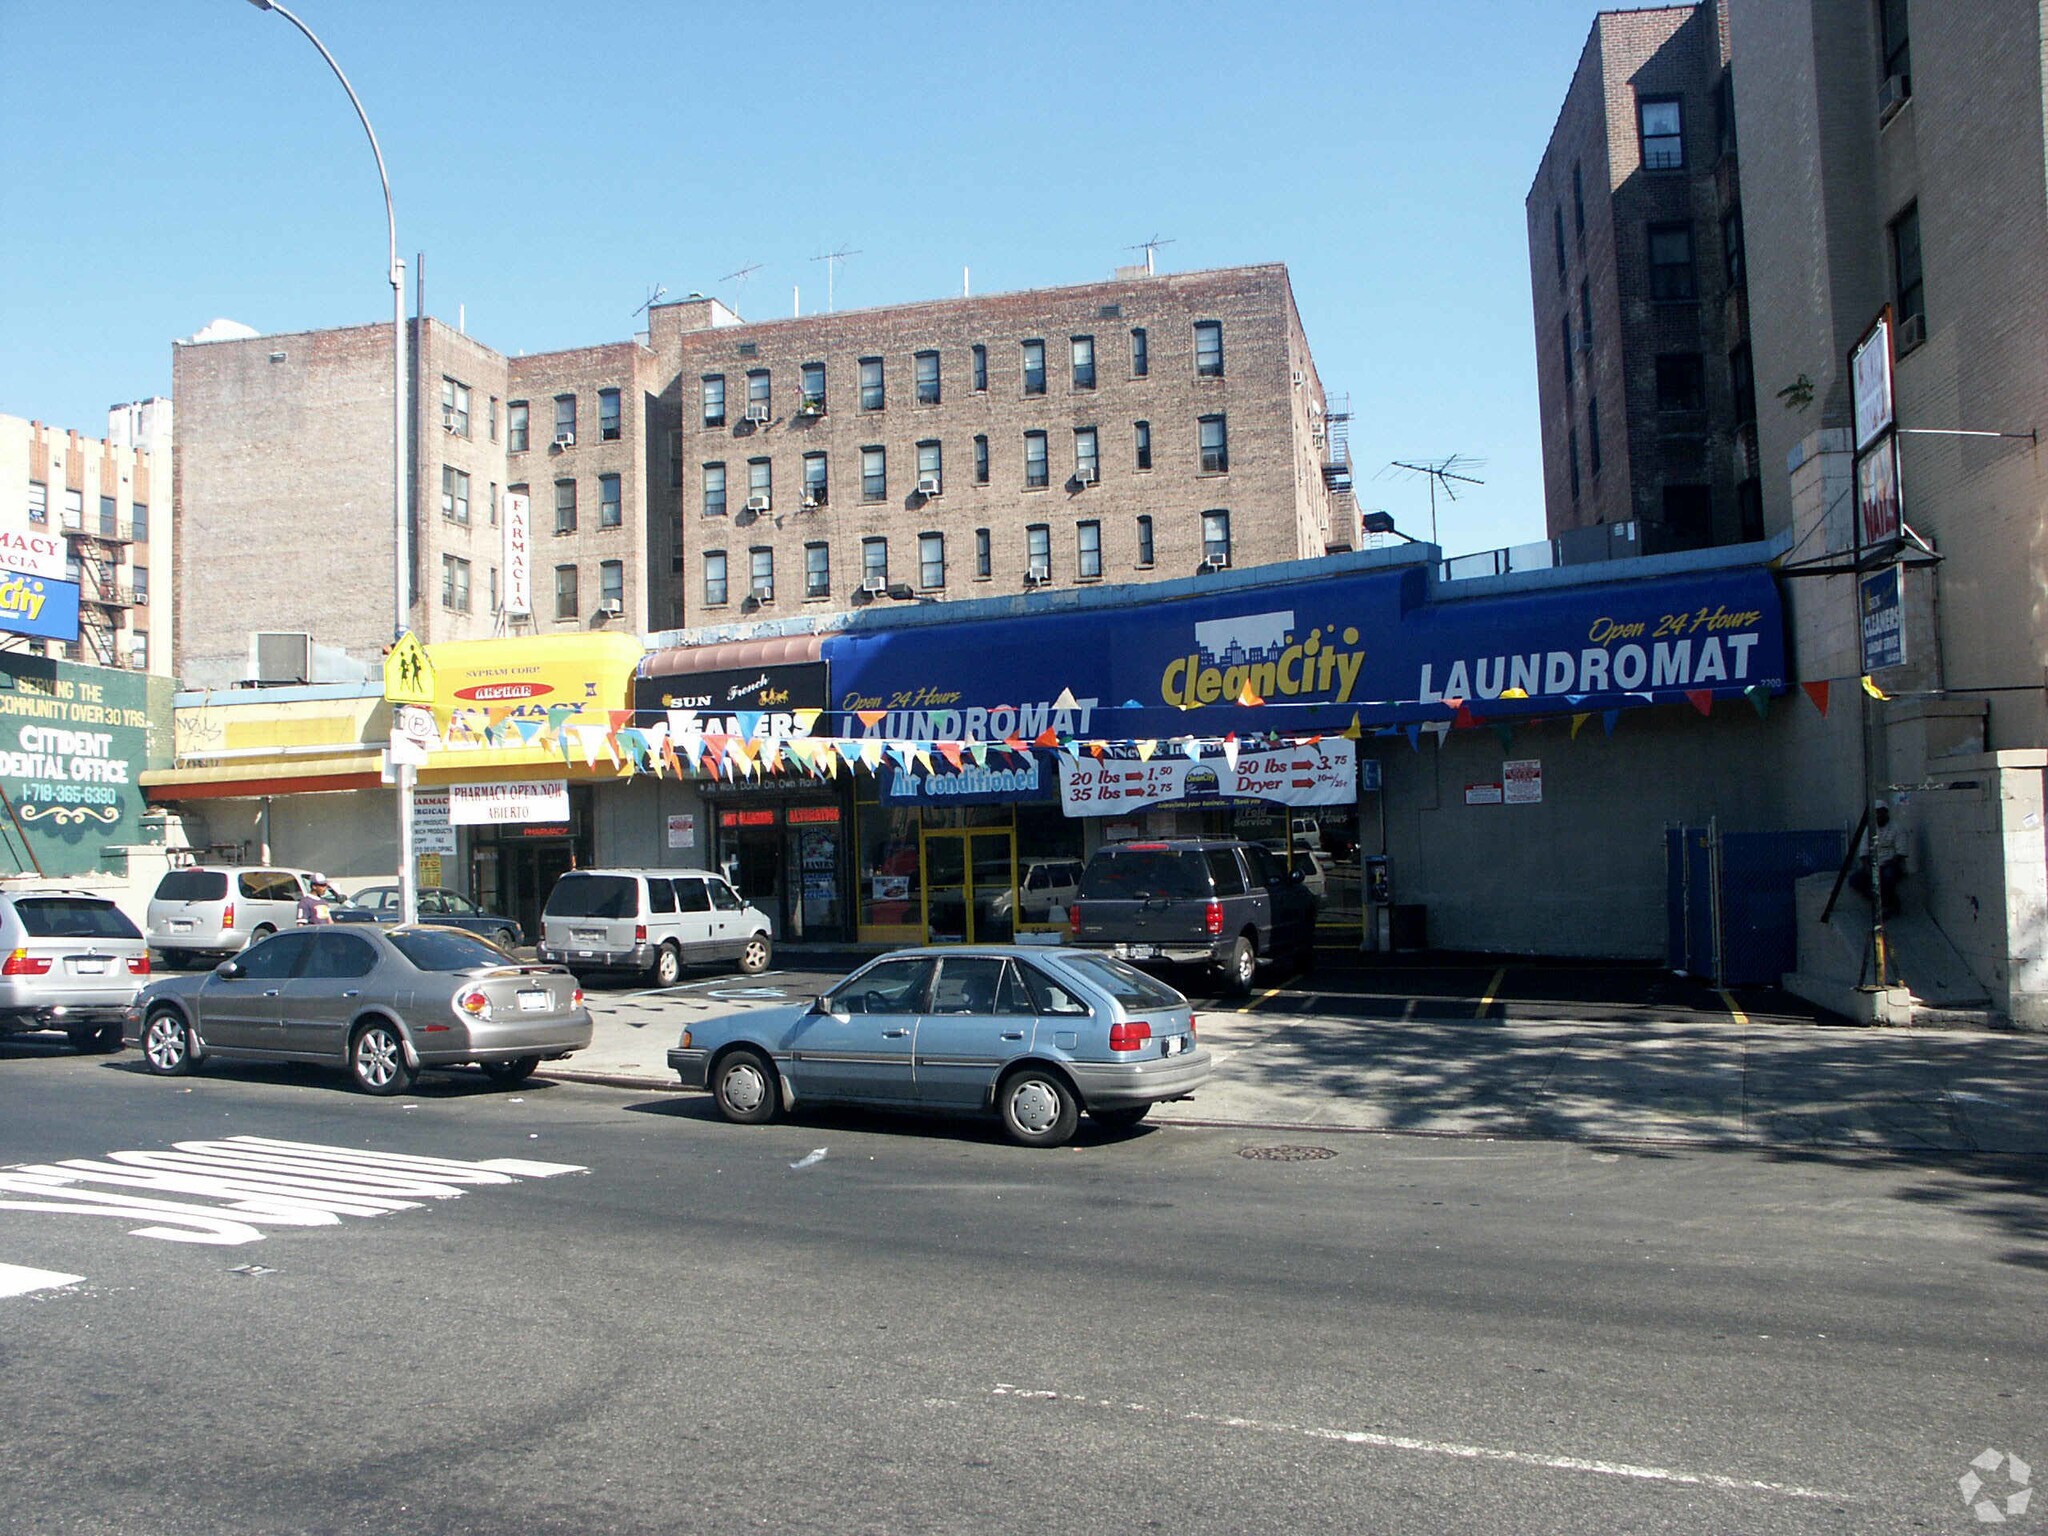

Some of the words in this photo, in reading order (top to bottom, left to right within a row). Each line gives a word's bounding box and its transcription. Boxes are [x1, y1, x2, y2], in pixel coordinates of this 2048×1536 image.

[512, 500, 524, 607] FARMACIA
[1589, 616, 1644, 646] Open
[1653, 614, 1688, 638] 24
[1690, 605, 1762, 634] Hours
[1161, 640, 1365, 706] CleanCity
[1420, 633, 1758, 704] LAUNDROMAT
[79, 683, 103, 703] THE
[726, 673, 770, 701] French
[843, 692, 881, 711] Open
[887, 692, 909, 708] 24
[911, 686, 961, 706] Hours
[670, 695, 712, 709] SUN
[71, 704, 104, 724] OVER
[105, 708, 121, 726] 30
[842, 697, 1098, 741] LAUNDROMAT
[19, 725, 113, 758] CITIDENT
[0, 751, 68, 780] DENTAL
[70, 757, 129, 784] OFFICE
[1070, 772, 1092, 786] 20
[1098, 770, 1120, 784] lbs
[1237, 760, 1259, 775] 50
[1265, 758, 1287, 773] lbs
[764, 780, 775, 789] On
[779, 779, 796, 788] Own
[890, 766, 920, 796] Air
[925, 764, 1039, 796] conditioned
[1237, 776, 1284, 793] Dryer
[454, 785, 507, 802] PHARMACY
[510, 784, 537, 800] OPEN
[541, 782, 562, 798] NOW
[1070, 788, 1092, 801] 35
[1098, 785, 1120, 800] lbs
[489, 806, 529, 819] ABIERTO
